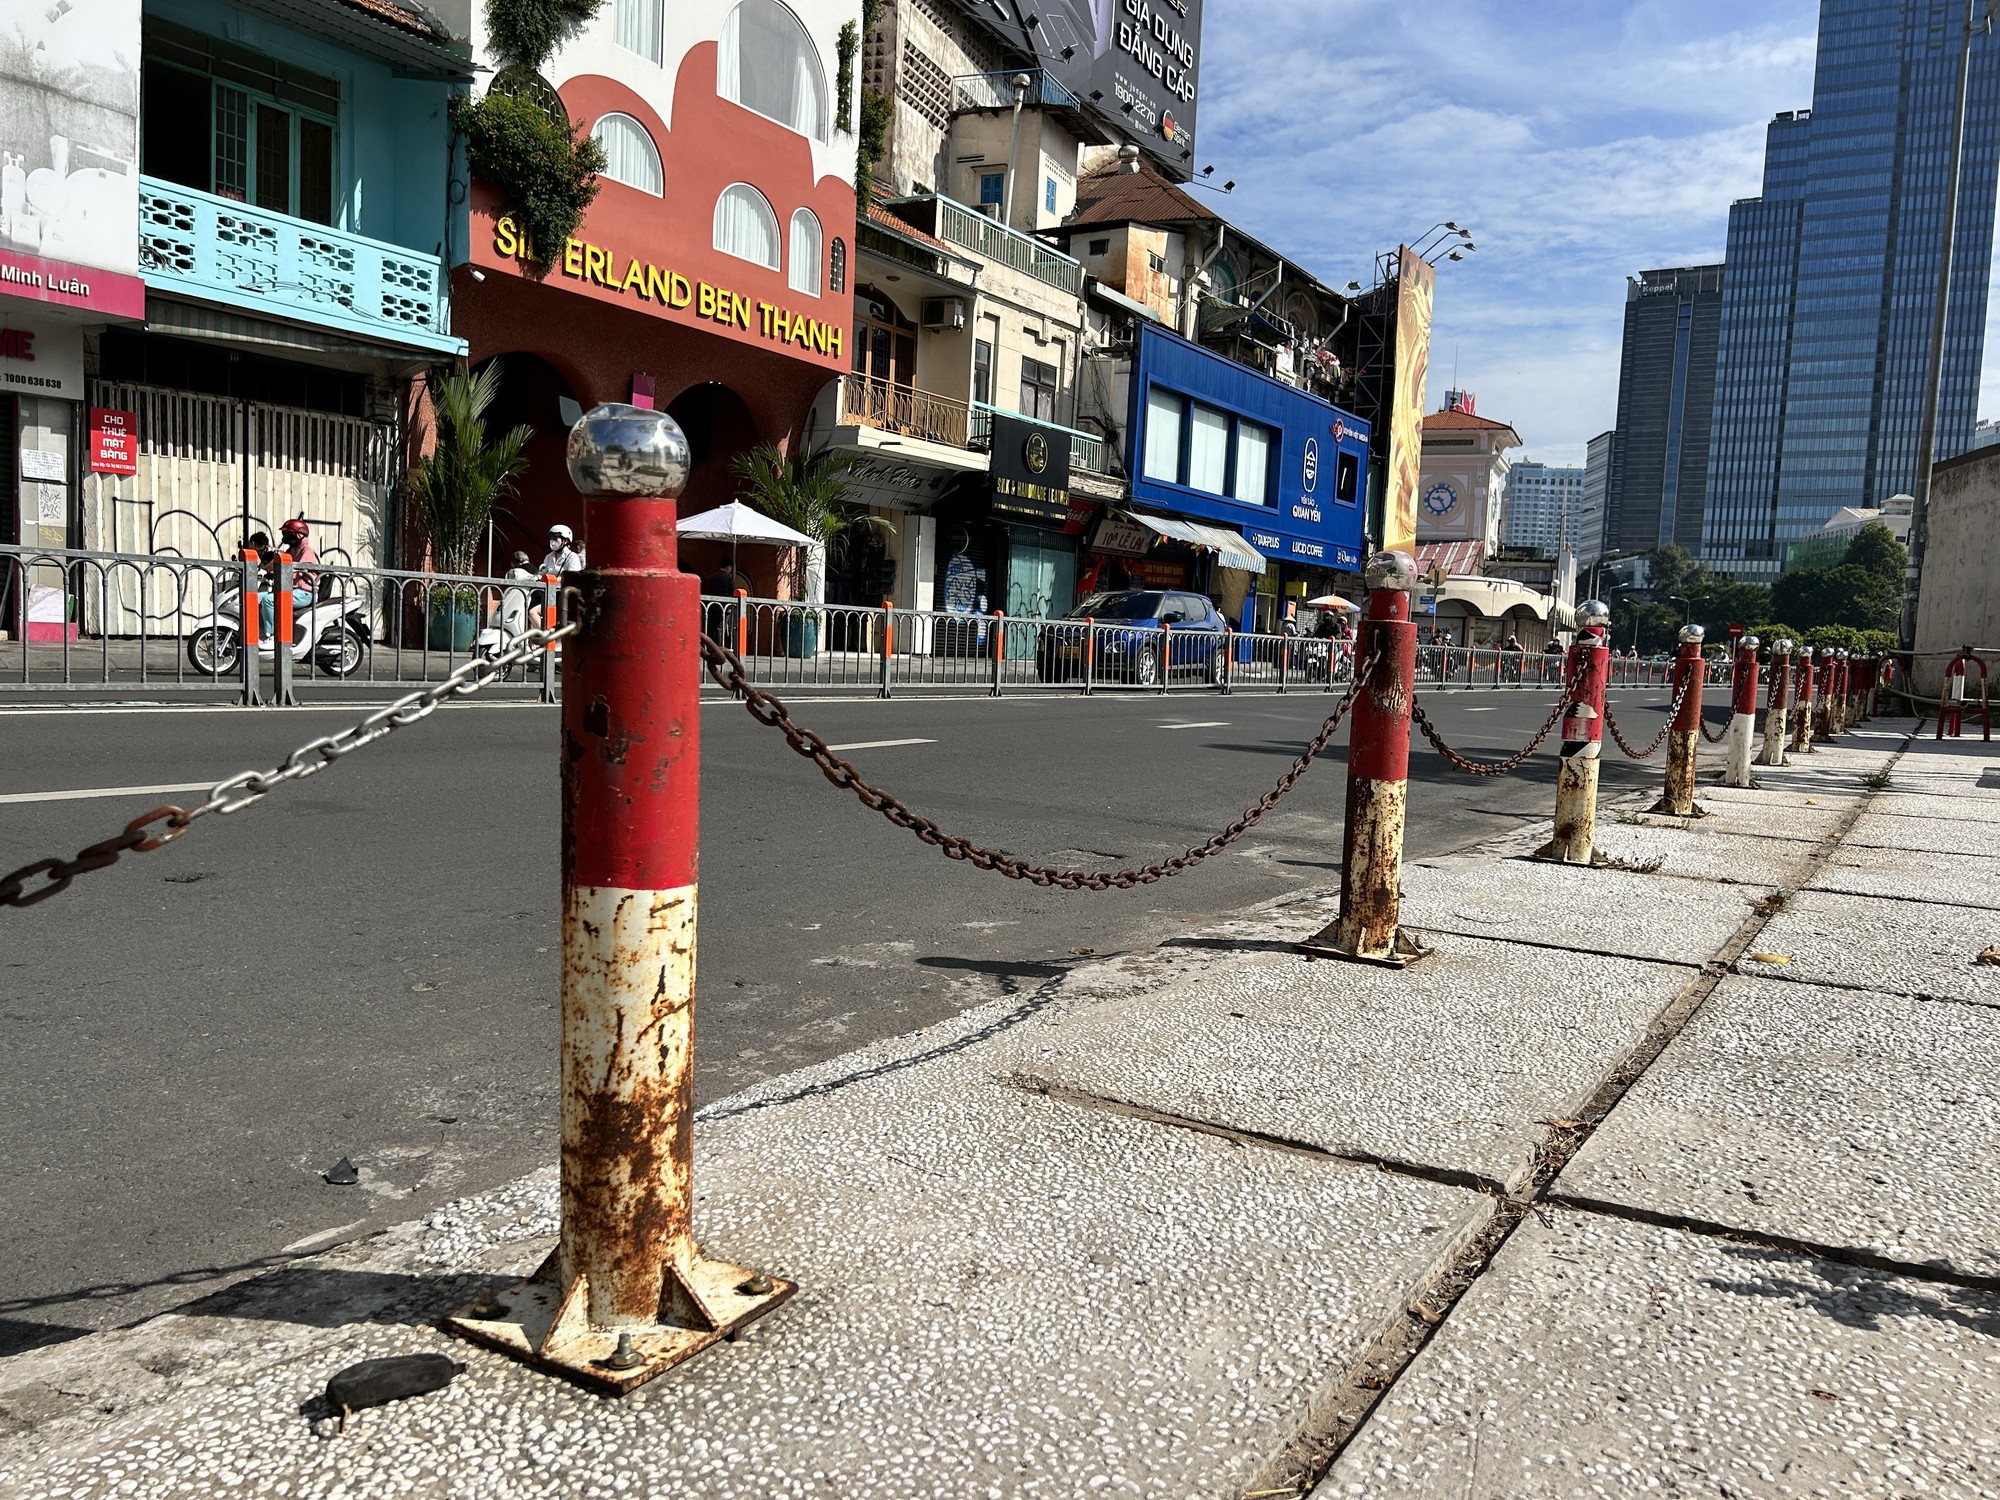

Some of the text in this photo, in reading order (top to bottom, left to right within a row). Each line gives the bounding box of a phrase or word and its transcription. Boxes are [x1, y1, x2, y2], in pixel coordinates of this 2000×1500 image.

[1126, 0, 1193, 69] GIA DỤNG
[1167, 65, 1195, 103] CẤP
[1, 264, 90, 297] Minh Luân
[497, 216, 843, 357] SILERLAND BEN THANH
[1642, 283, 1673, 293] Keppel
[4, 373, 27, 385] 1900
[28, 376, 45, 387] 636
[104, 414, 124, 425] CHO
[1292, 505, 1310, 520] QUAN
